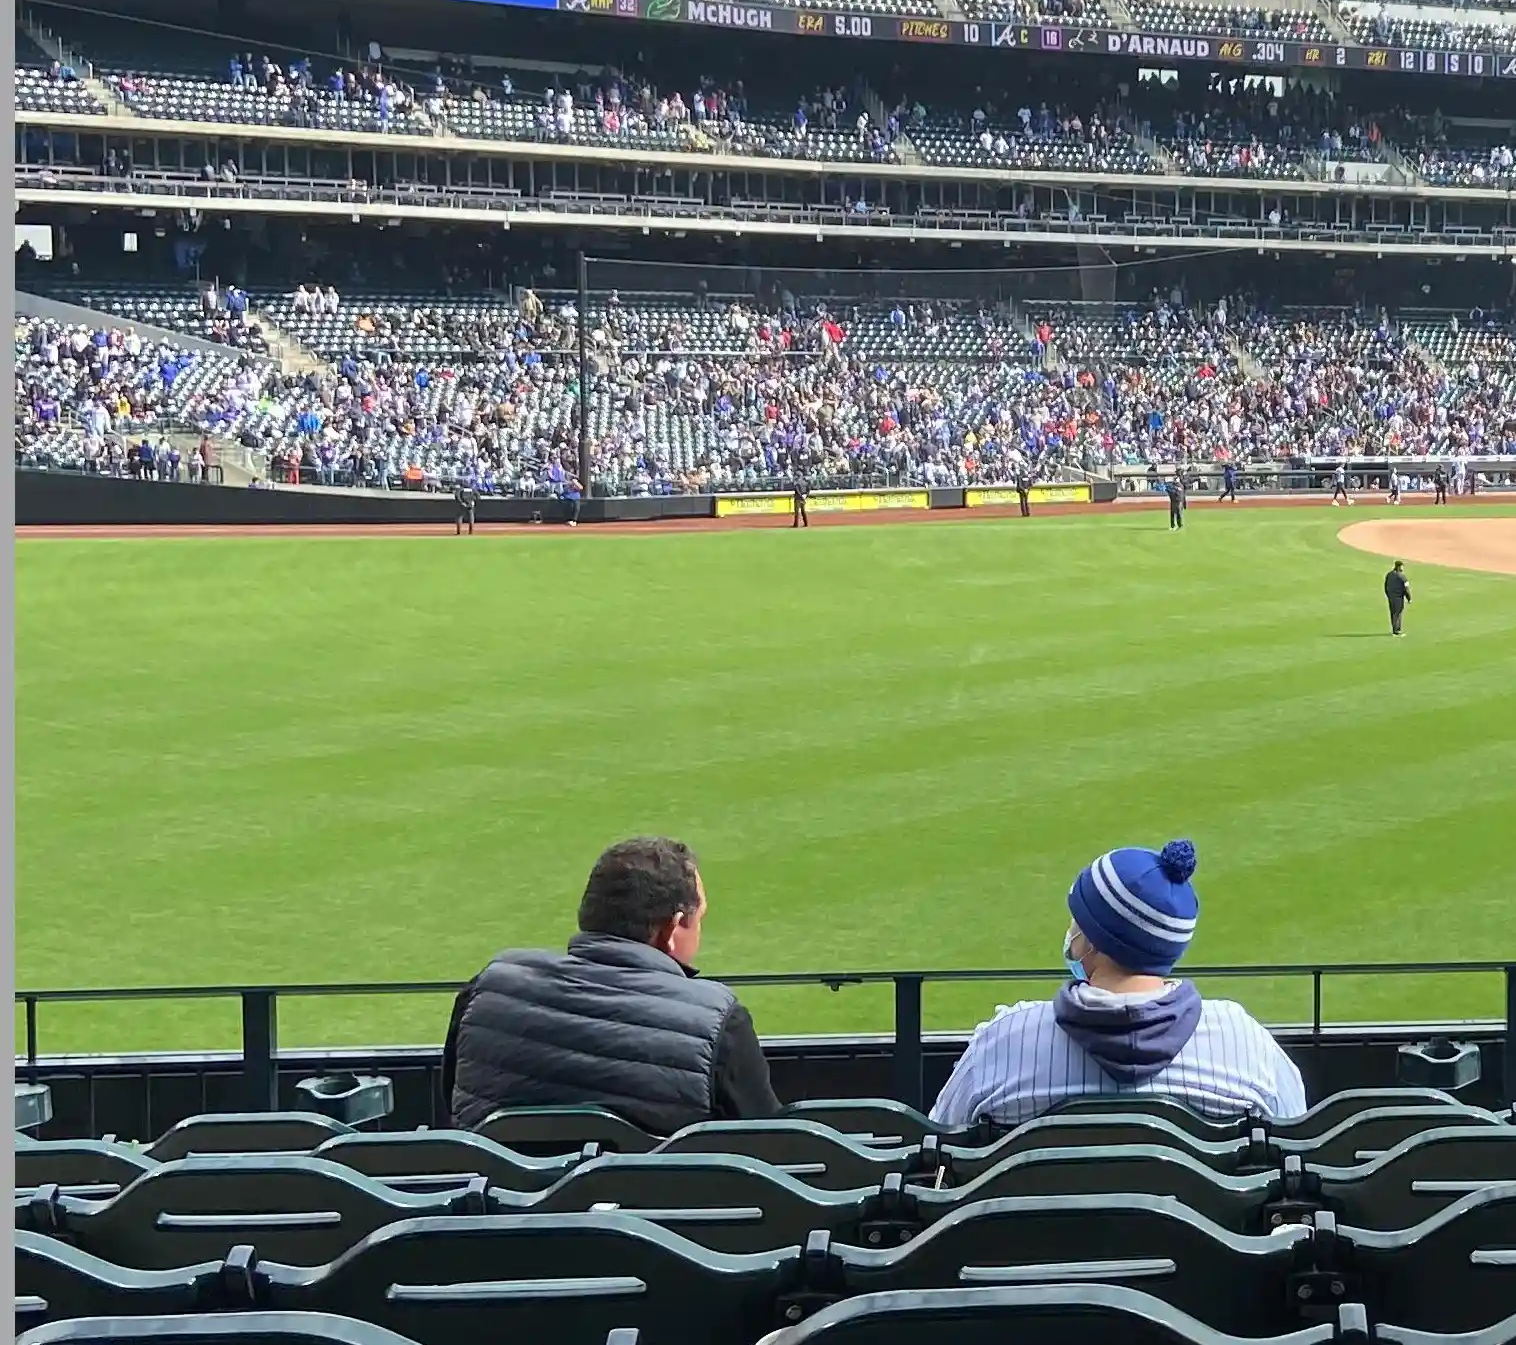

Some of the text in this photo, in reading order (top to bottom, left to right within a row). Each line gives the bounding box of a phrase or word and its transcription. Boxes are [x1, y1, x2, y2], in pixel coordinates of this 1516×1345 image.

[798, 15, 824, 32] ERA
[835, 15, 872, 37] 5.00
[901, 21, 948, 39] PITCHES
[963, 23, 980, 43] 10
[1020, 29, 1028, 44] C
[1108, 34, 1210, 57] D'ARNAUD
[1252, 42, 1284, 62] .304
[1305, 48, 1320, 62] HR
[1336, 48, 1346, 65] 2
[1368, 51, 1389, 66] RBI
[1400, 51, 1414, 69] 12
